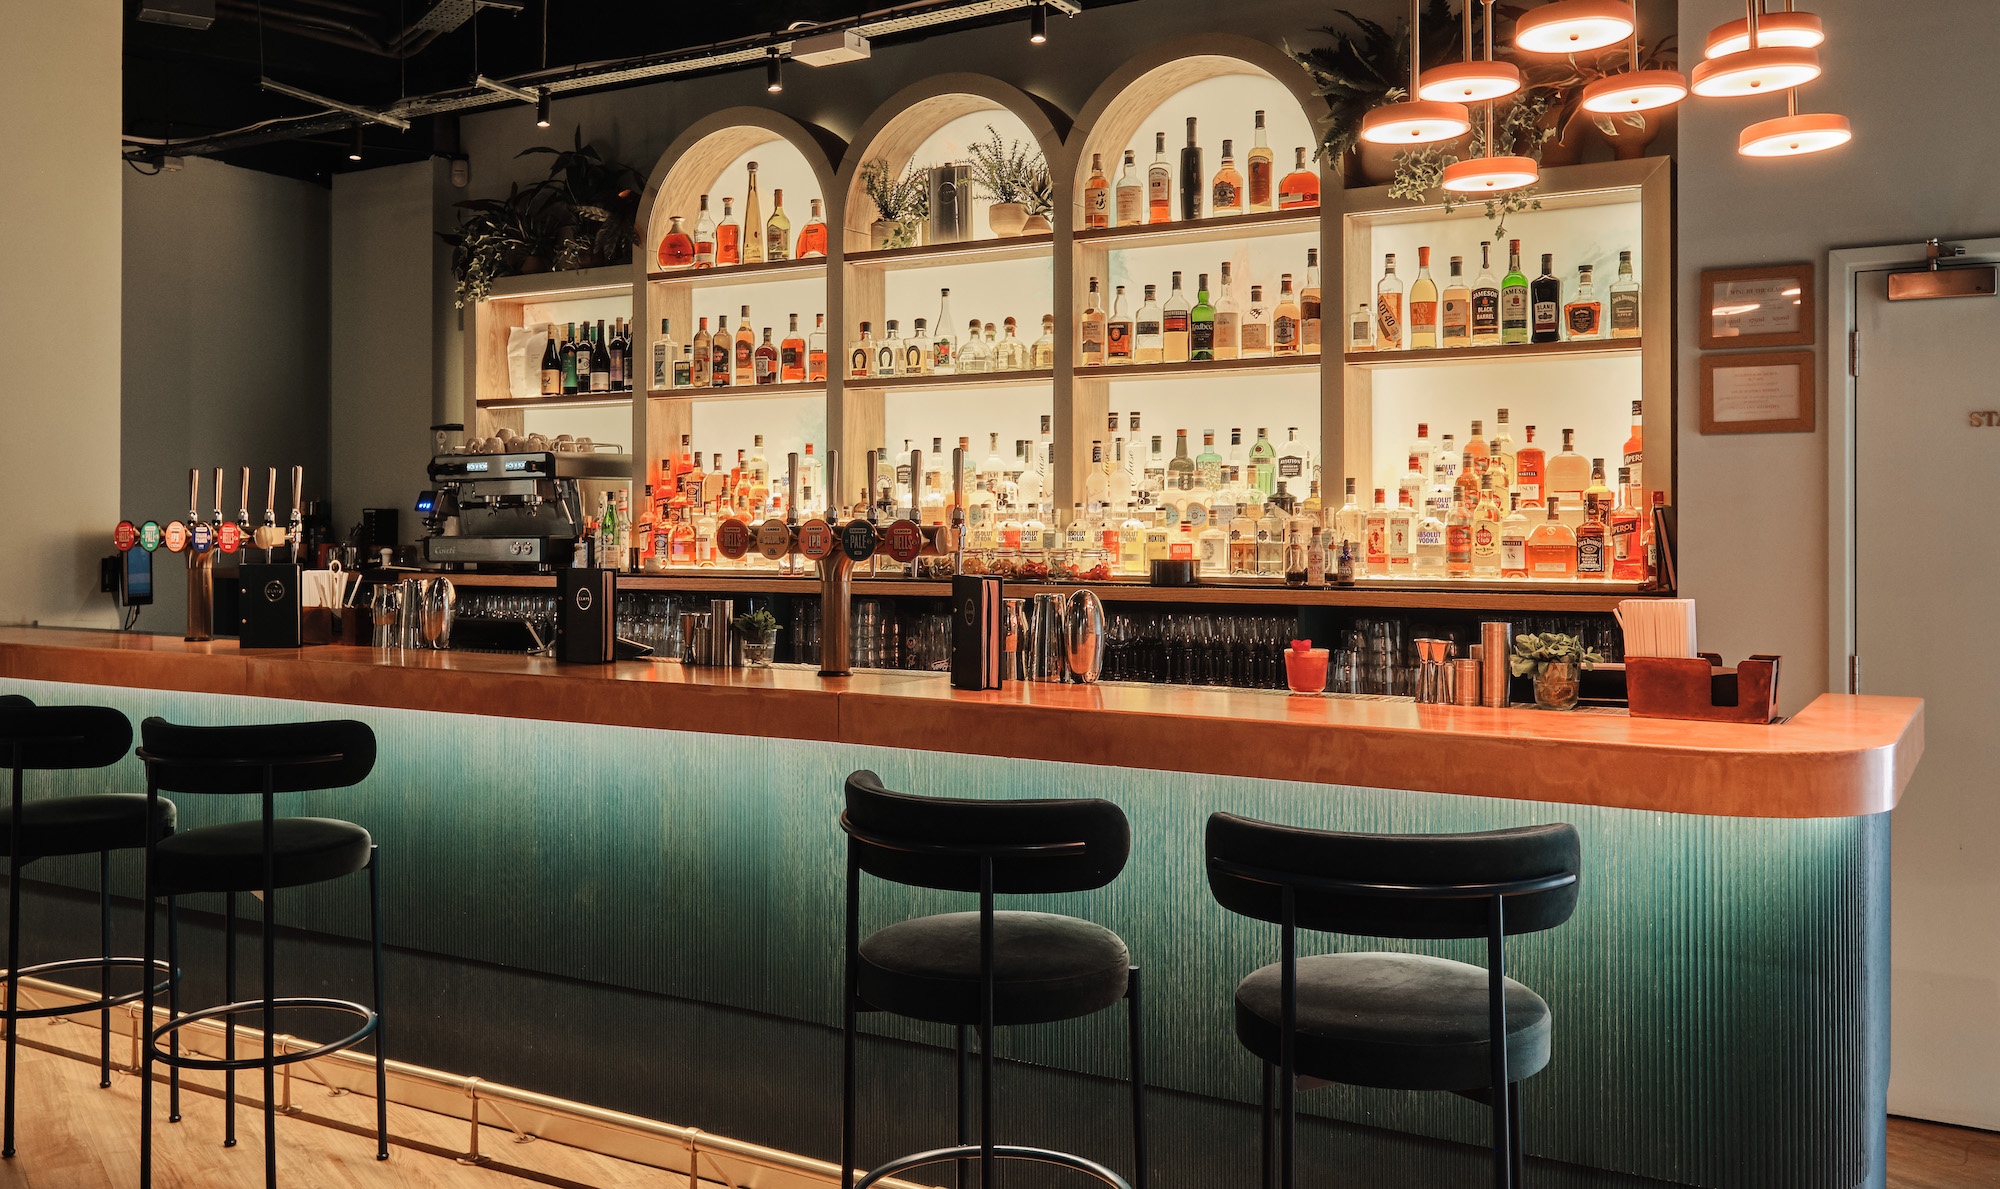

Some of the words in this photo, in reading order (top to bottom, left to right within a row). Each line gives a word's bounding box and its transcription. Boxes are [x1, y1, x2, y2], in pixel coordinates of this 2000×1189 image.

[1472, 291, 1498, 300] JAMESON
[1503, 288, 1528, 298] JAMESON
[1378, 299, 1388, 314] LOT
[1384, 312, 1395, 327] 40
[808, 534, 821, 548] IPA
[850, 534, 866, 549] PALE
[894, 535, 913, 550] HELLS
